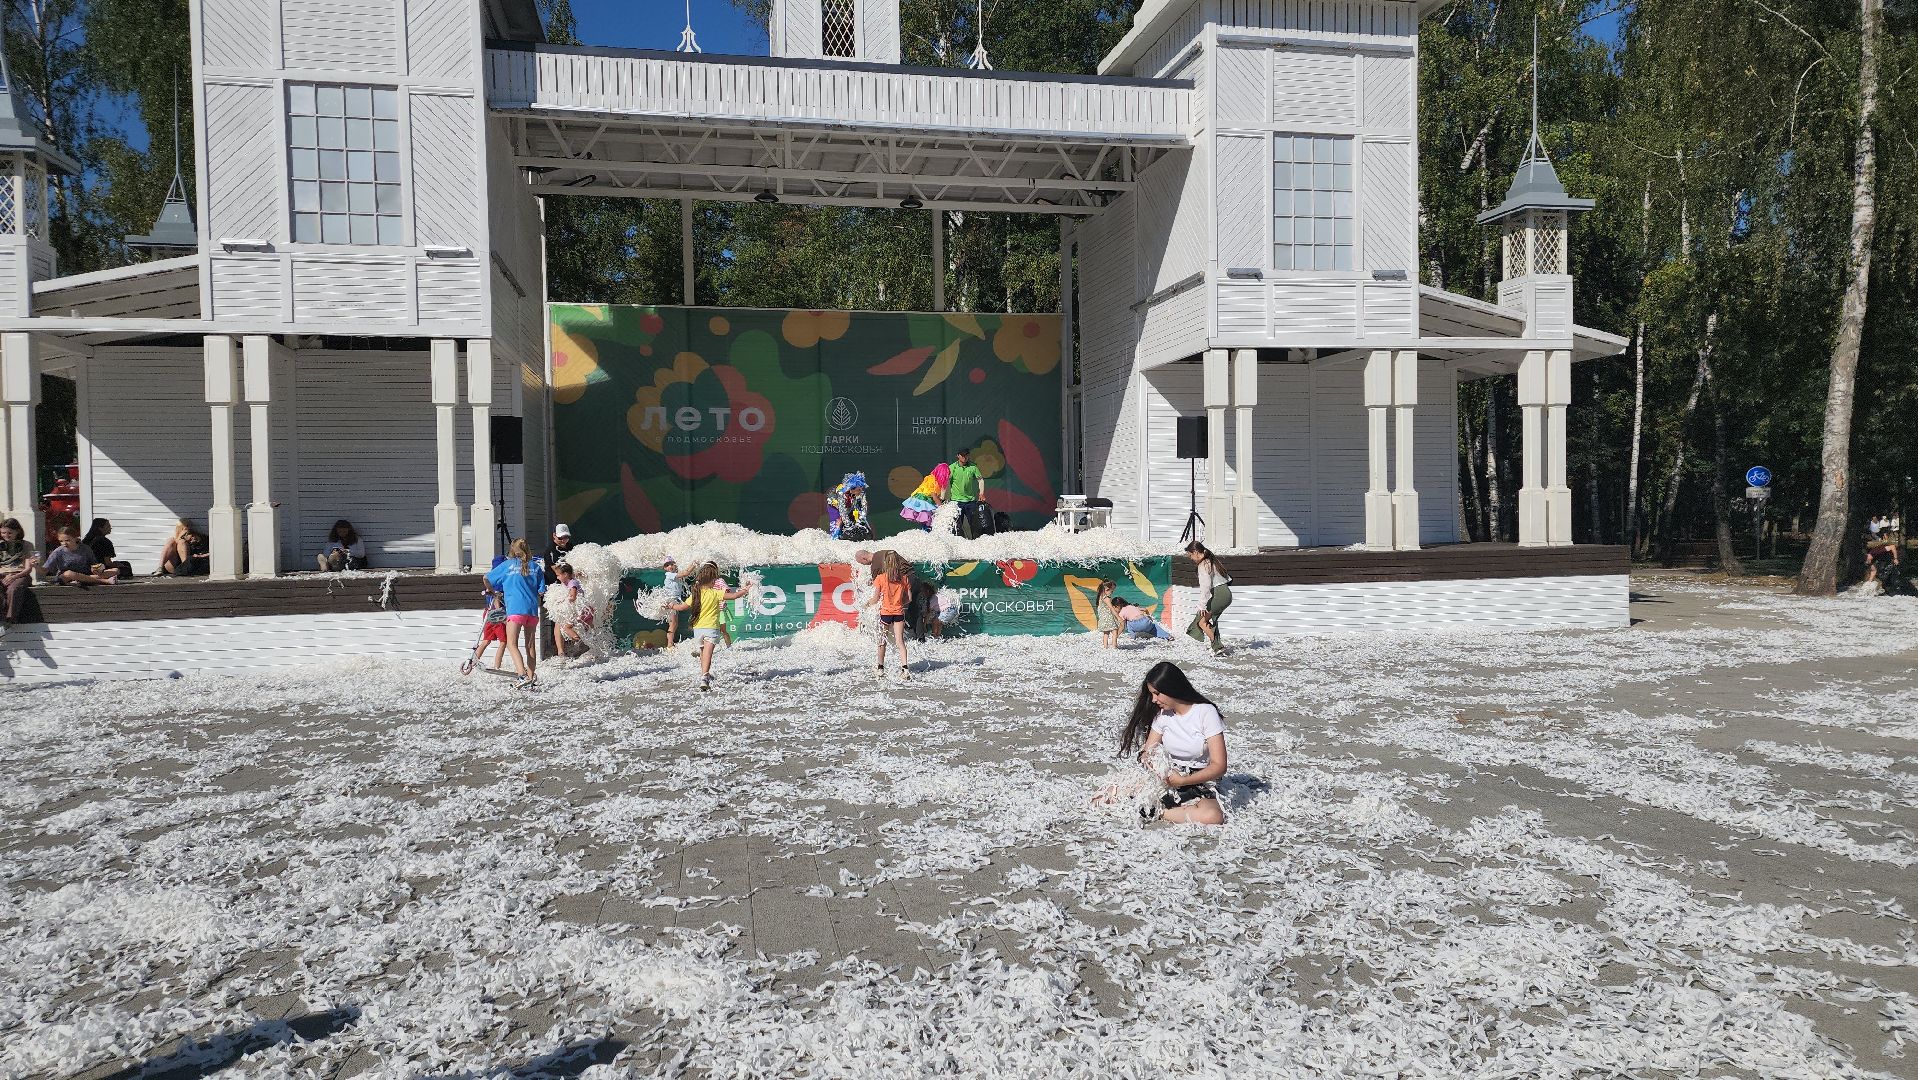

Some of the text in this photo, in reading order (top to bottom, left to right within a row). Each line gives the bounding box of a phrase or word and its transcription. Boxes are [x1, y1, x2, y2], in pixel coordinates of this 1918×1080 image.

[640, 405, 766, 432] лето
[912, 414, 983, 426] ЦЕНТРАЛЬНЫЙ
[912, 426, 937, 436] ПАРК
[824, 435, 859, 445] ПАРКИ
[801, 445, 883, 455] ПОДМОСКОВЬЯ
[958, 587, 988, 600] РКИ
[959, 600, 1055, 614] ДМОСКОВЬЯ
[745, 620, 849, 632] ПОДМОСКОЕ
